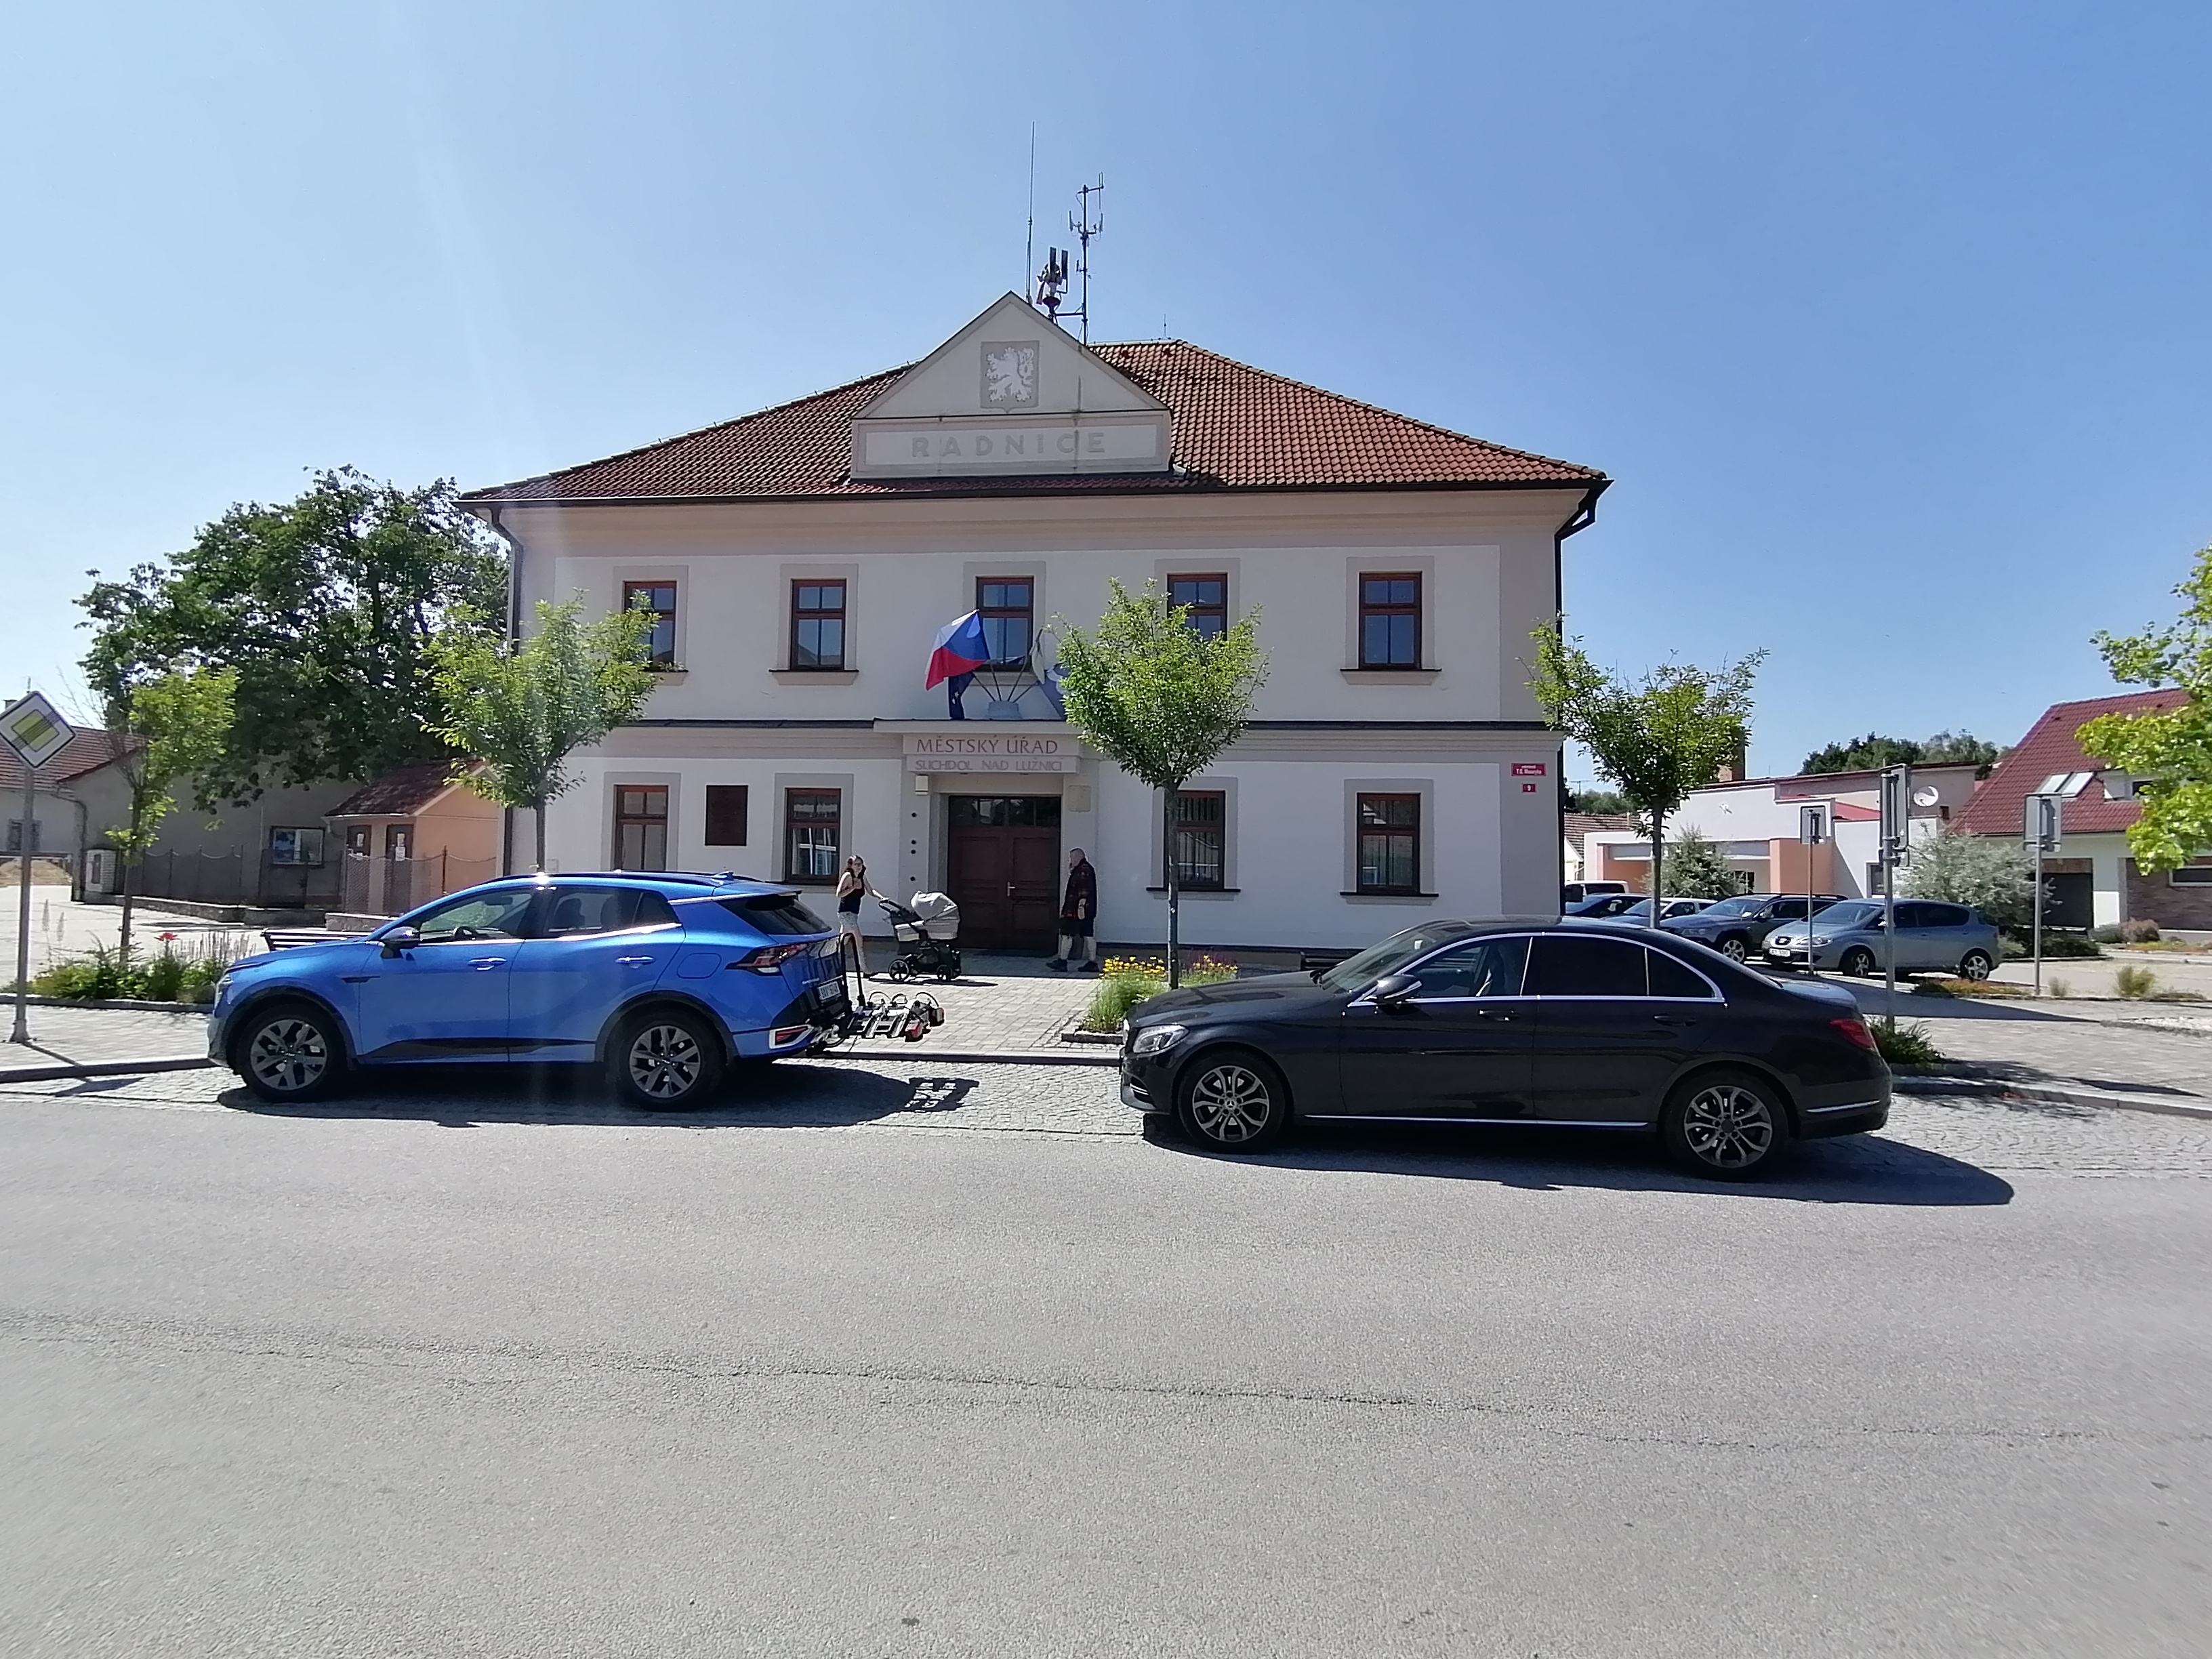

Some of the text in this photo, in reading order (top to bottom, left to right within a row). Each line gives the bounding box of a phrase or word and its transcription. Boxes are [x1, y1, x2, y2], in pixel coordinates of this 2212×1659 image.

[911, 432, 1106, 458] RADNICE
[916, 735, 1058, 754] MĚSTSKÝ ÚŘAD
[916, 759, 972, 771] SUCHDOL
[981, 760, 1009, 771] NAD
